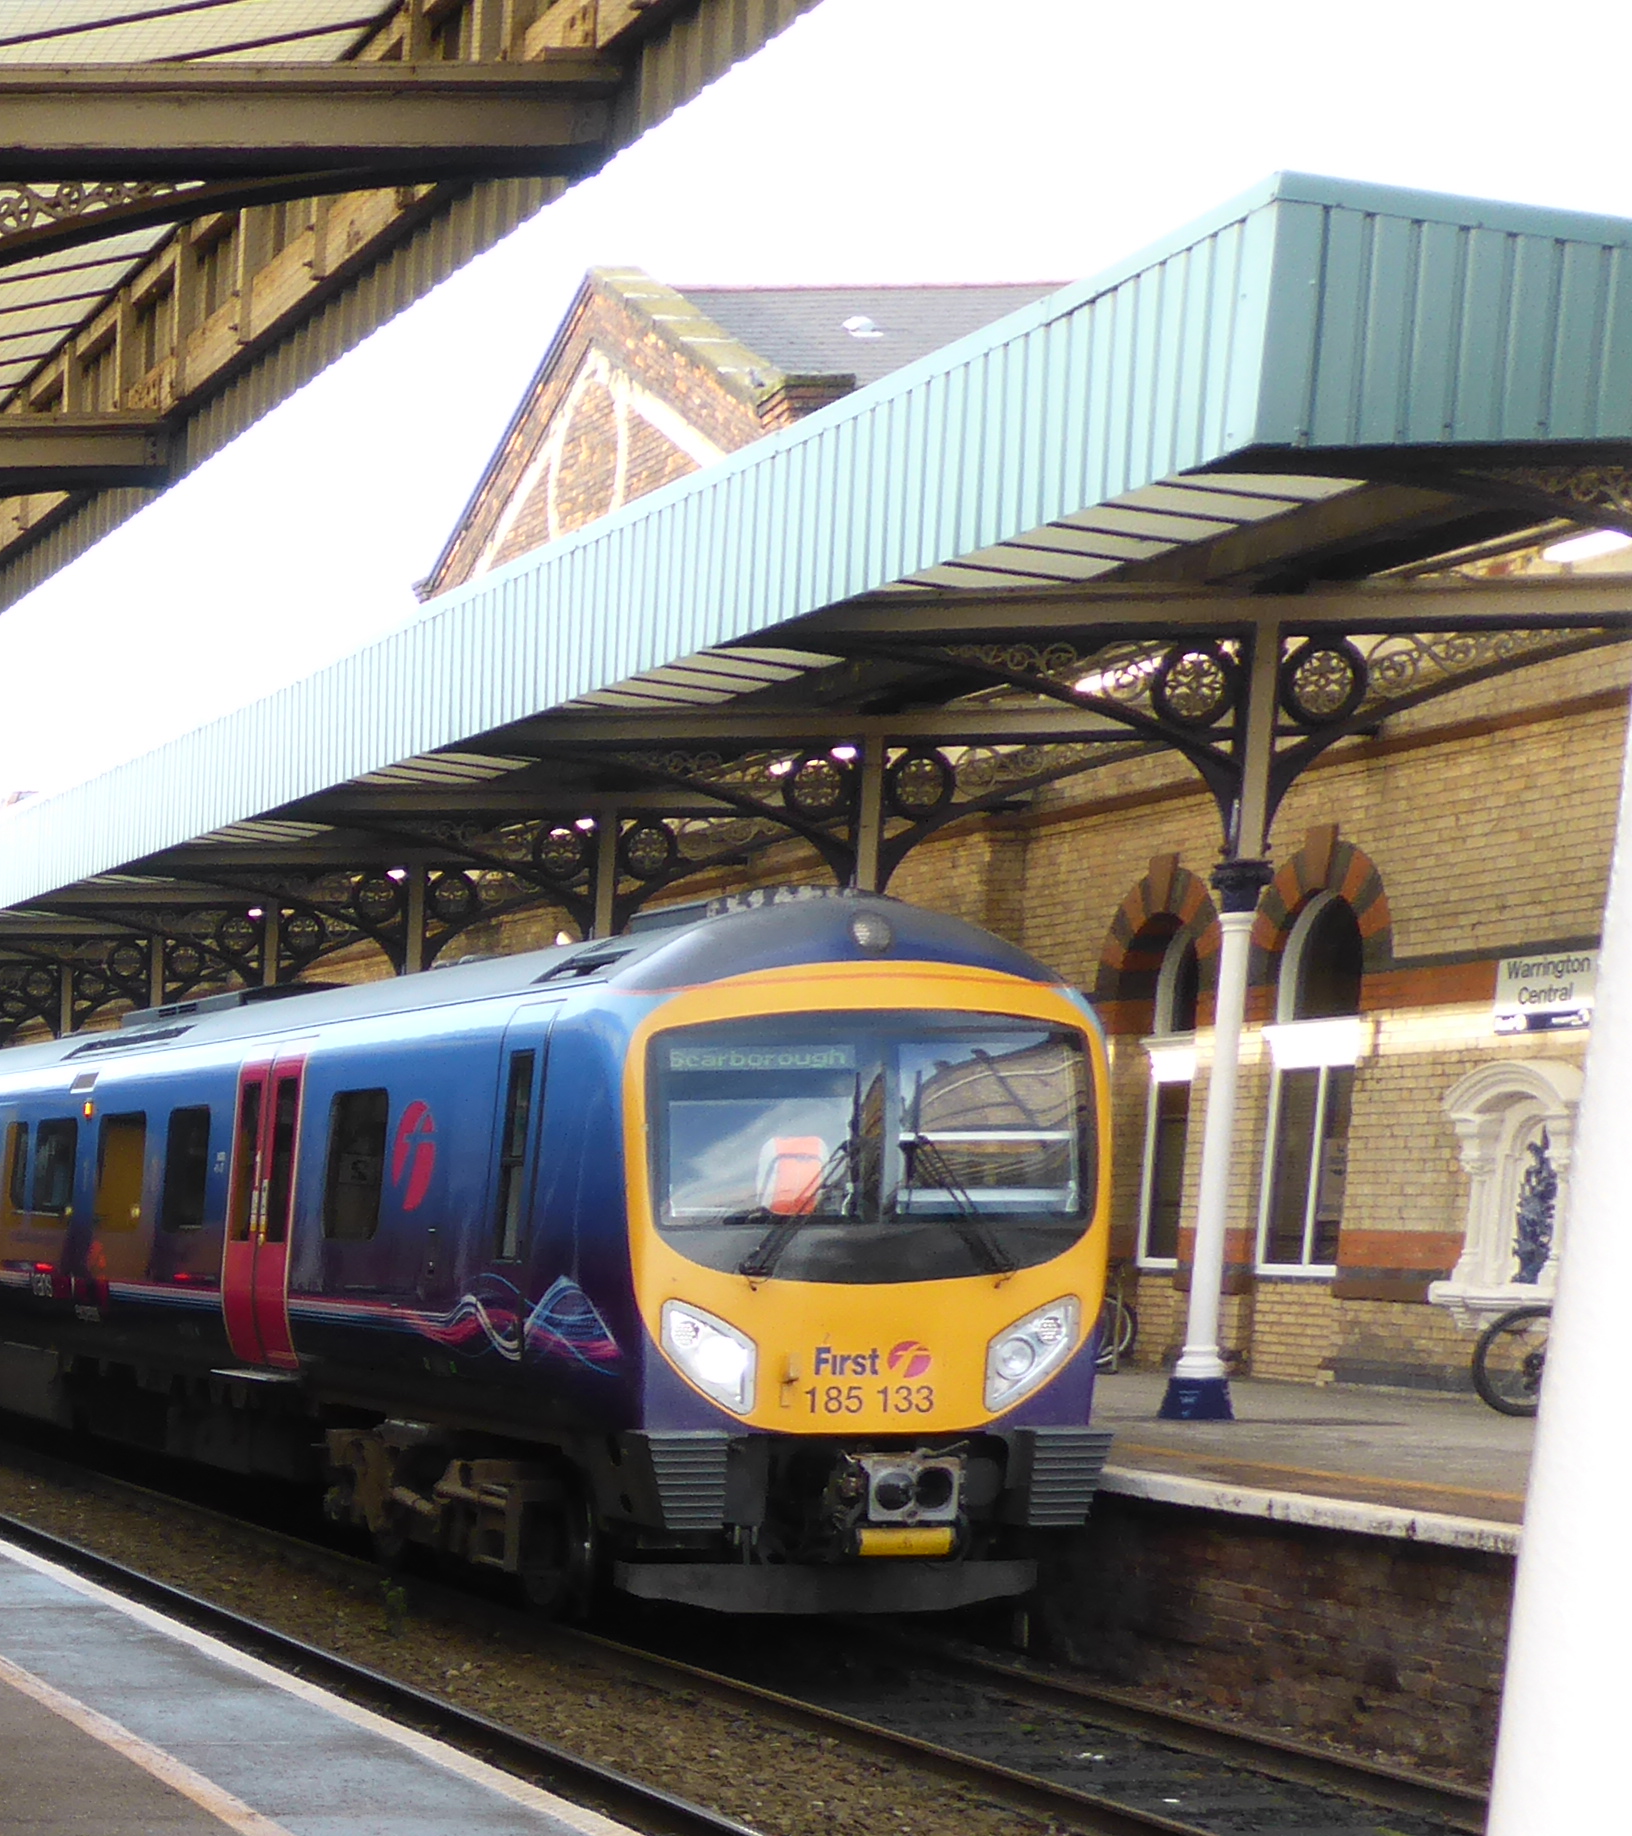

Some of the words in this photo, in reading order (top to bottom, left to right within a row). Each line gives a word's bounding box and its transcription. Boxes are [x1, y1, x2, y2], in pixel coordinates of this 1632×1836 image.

[1507, 955, 1591, 979] Warrington
[1518, 982, 1573, 1005] Central
[670, 1049, 846, 1069] Scarborough
[814, 1347, 880, 1375] First
[805, 1386, 863, 1413] 185
[877, 1385, 934, 1413] 133
